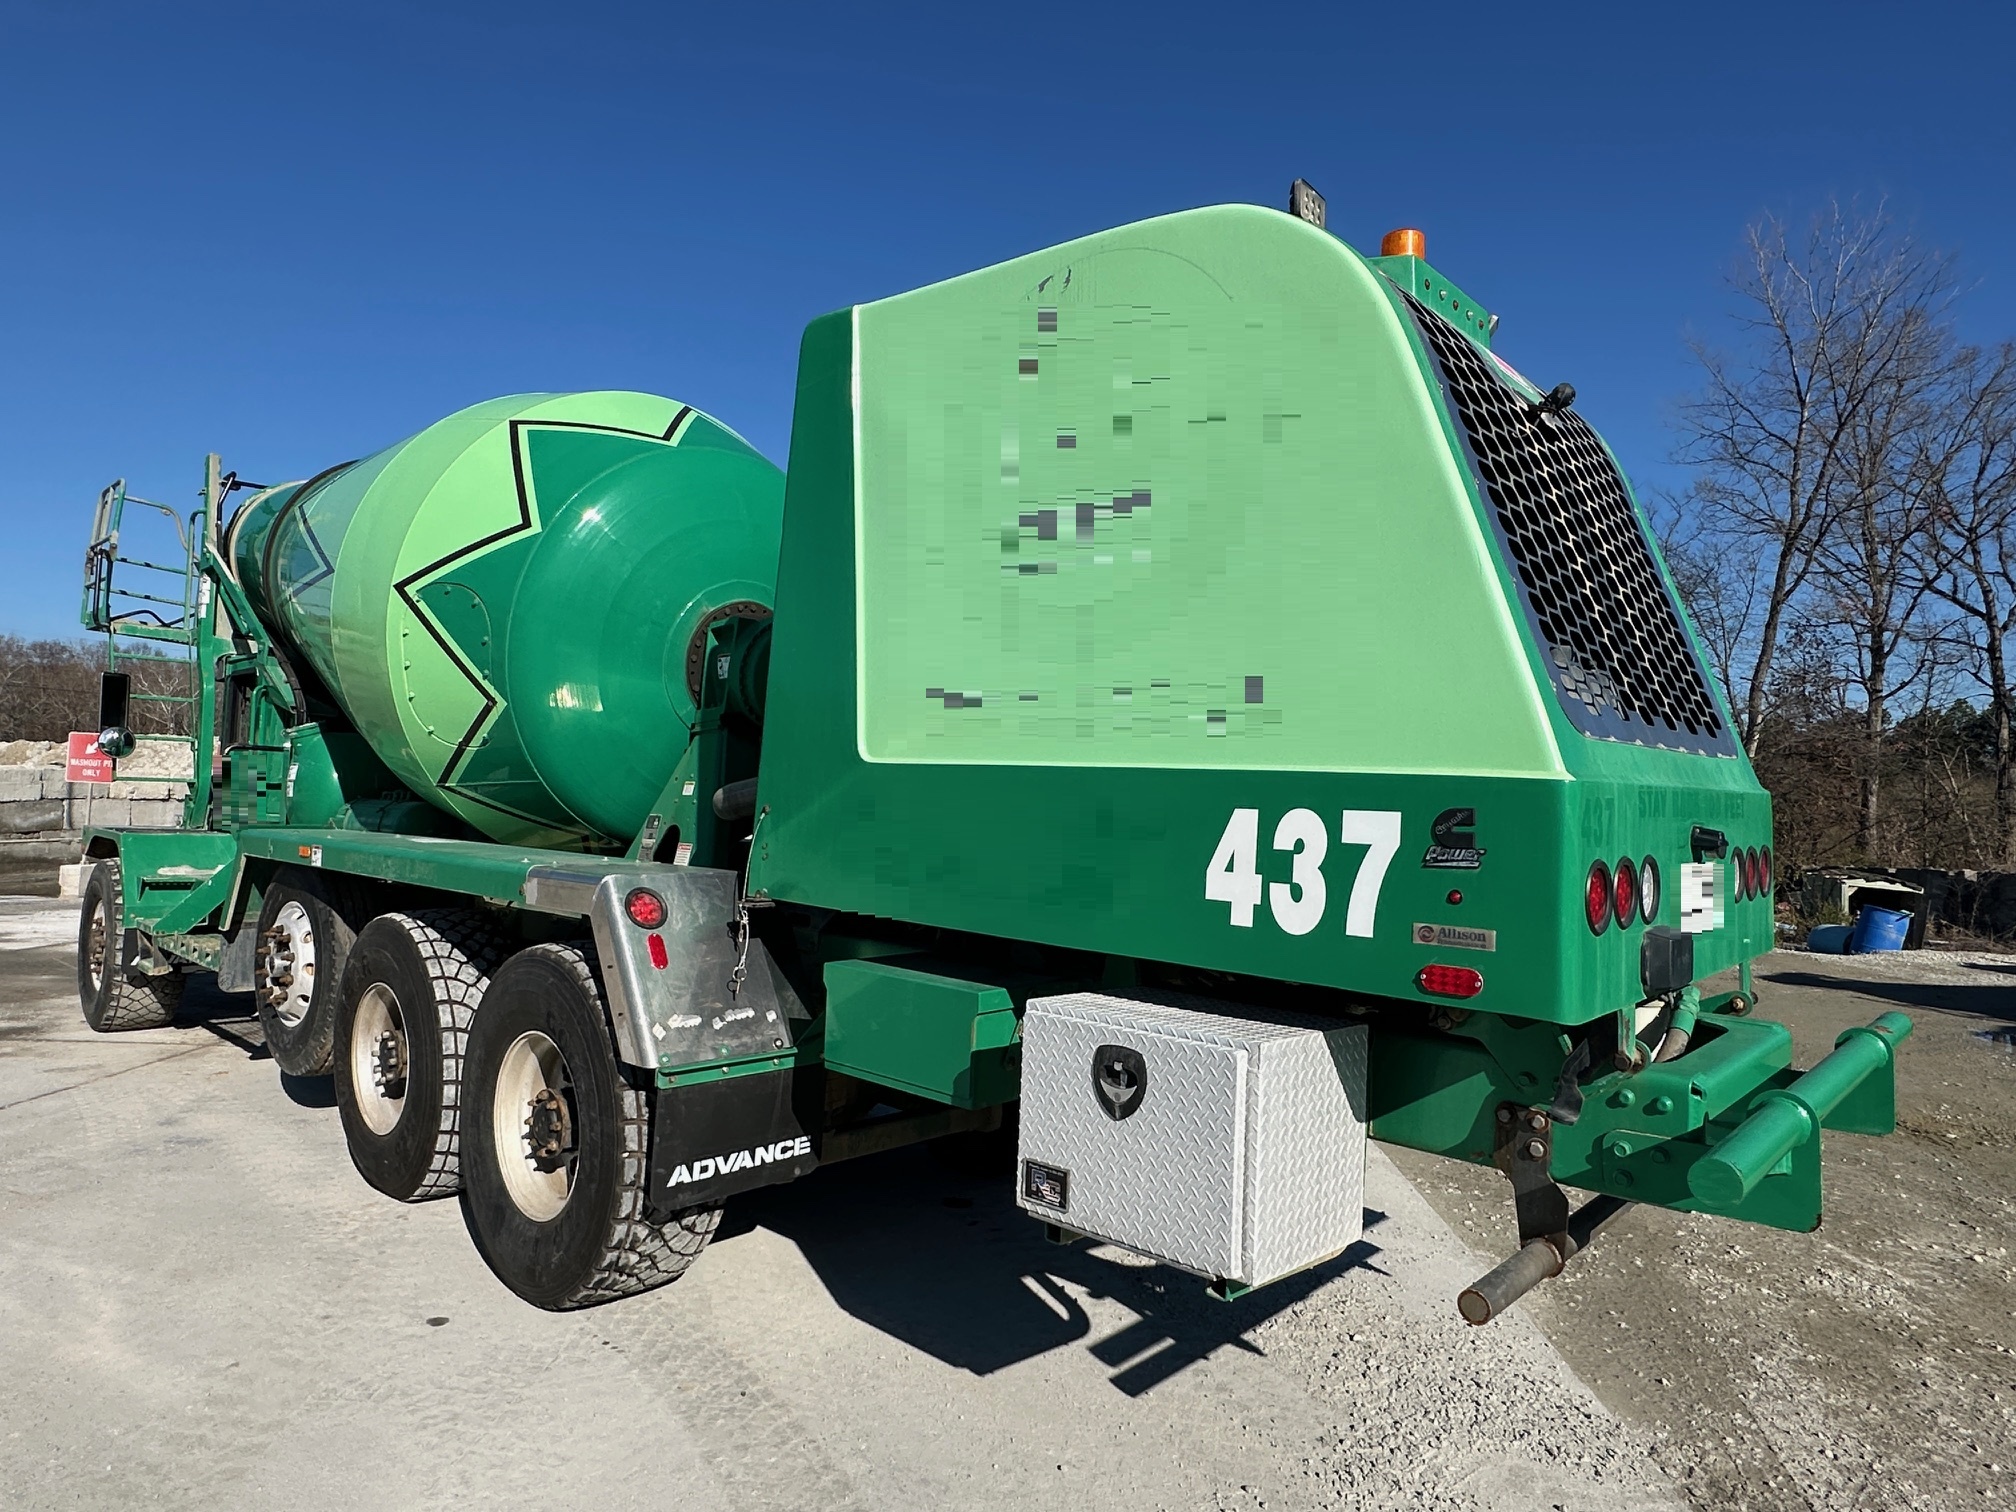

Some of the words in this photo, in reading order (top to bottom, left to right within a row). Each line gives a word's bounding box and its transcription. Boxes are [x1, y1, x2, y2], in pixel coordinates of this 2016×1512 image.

[70, 758, 102, 767] WASHOUT
[82, 769, 101, 777] ONLY
[1581, 796, 1615, 848] 437
[1205, 807, 1402, 938] 437
[1437, 927, 1487, 942] Allison
[666, 1135, 811, 1188] ADVANCE
